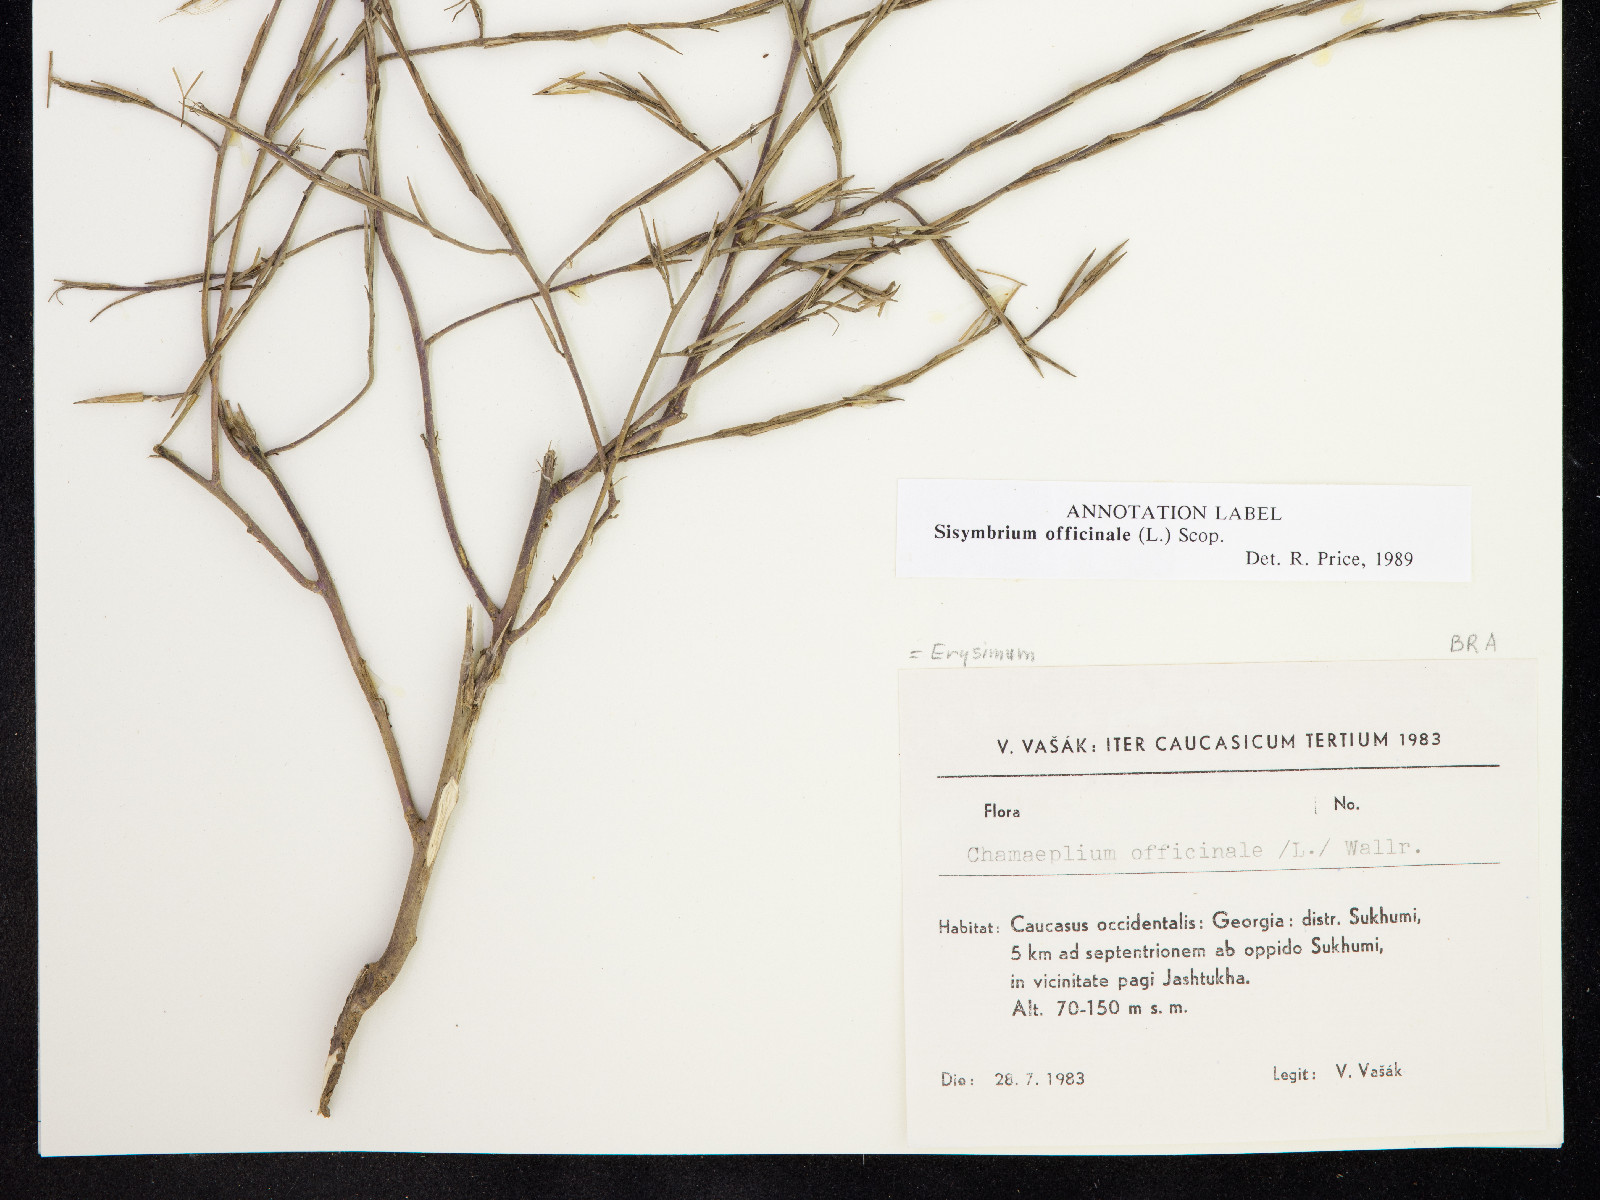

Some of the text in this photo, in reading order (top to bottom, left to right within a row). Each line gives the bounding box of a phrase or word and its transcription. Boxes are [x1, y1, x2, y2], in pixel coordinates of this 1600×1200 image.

[1066, 503, 1283, 522] ANNOTATION LABEL
[934, 523, 1224, 546] Sisymbrium officinale (L.) Scop.
[1245, 550, 1414, 569] Det. R. Price, 1989
[930, 642, 1036, 668] Erysimum
[996, 731, 1442, 755] V. VAŠÁK: ITER CAUCASICUM TERTIUM 1983
[984, 795, 1361, 818] Flora No.
[966, 843, 1117, 864] Chamaeplium
[1130, 841, 1264, 861] officinale
[1344, 837, 1422, 858] Wallr.
[938, 919, 1000, 935] Habitat:
[1010, 914, 1089, 933] Caucasus
[1096, 911, 1205, 932] occidentalis:
[1301, 908, 1342, 927] distr.
[1349, 906, 1422, 926] Sukhumi,
[1010, 935, 1384, 963] 5 km ad septentrionem ab oppido Sukhumi,
[1010, 966, 1251, 991] in vicinitate pagi Jashtukha.
[1011, 998, 1188, 1017] Alt. 70-150 m s. m.
[994, 1072, 1019, 1087] 28.
[1026, 1072, 1040, 1086] 7.
[1047, 1071, 1086, 1086] 1983
[1273, 1061, 1404, 1084] Legit: V. Vašák
